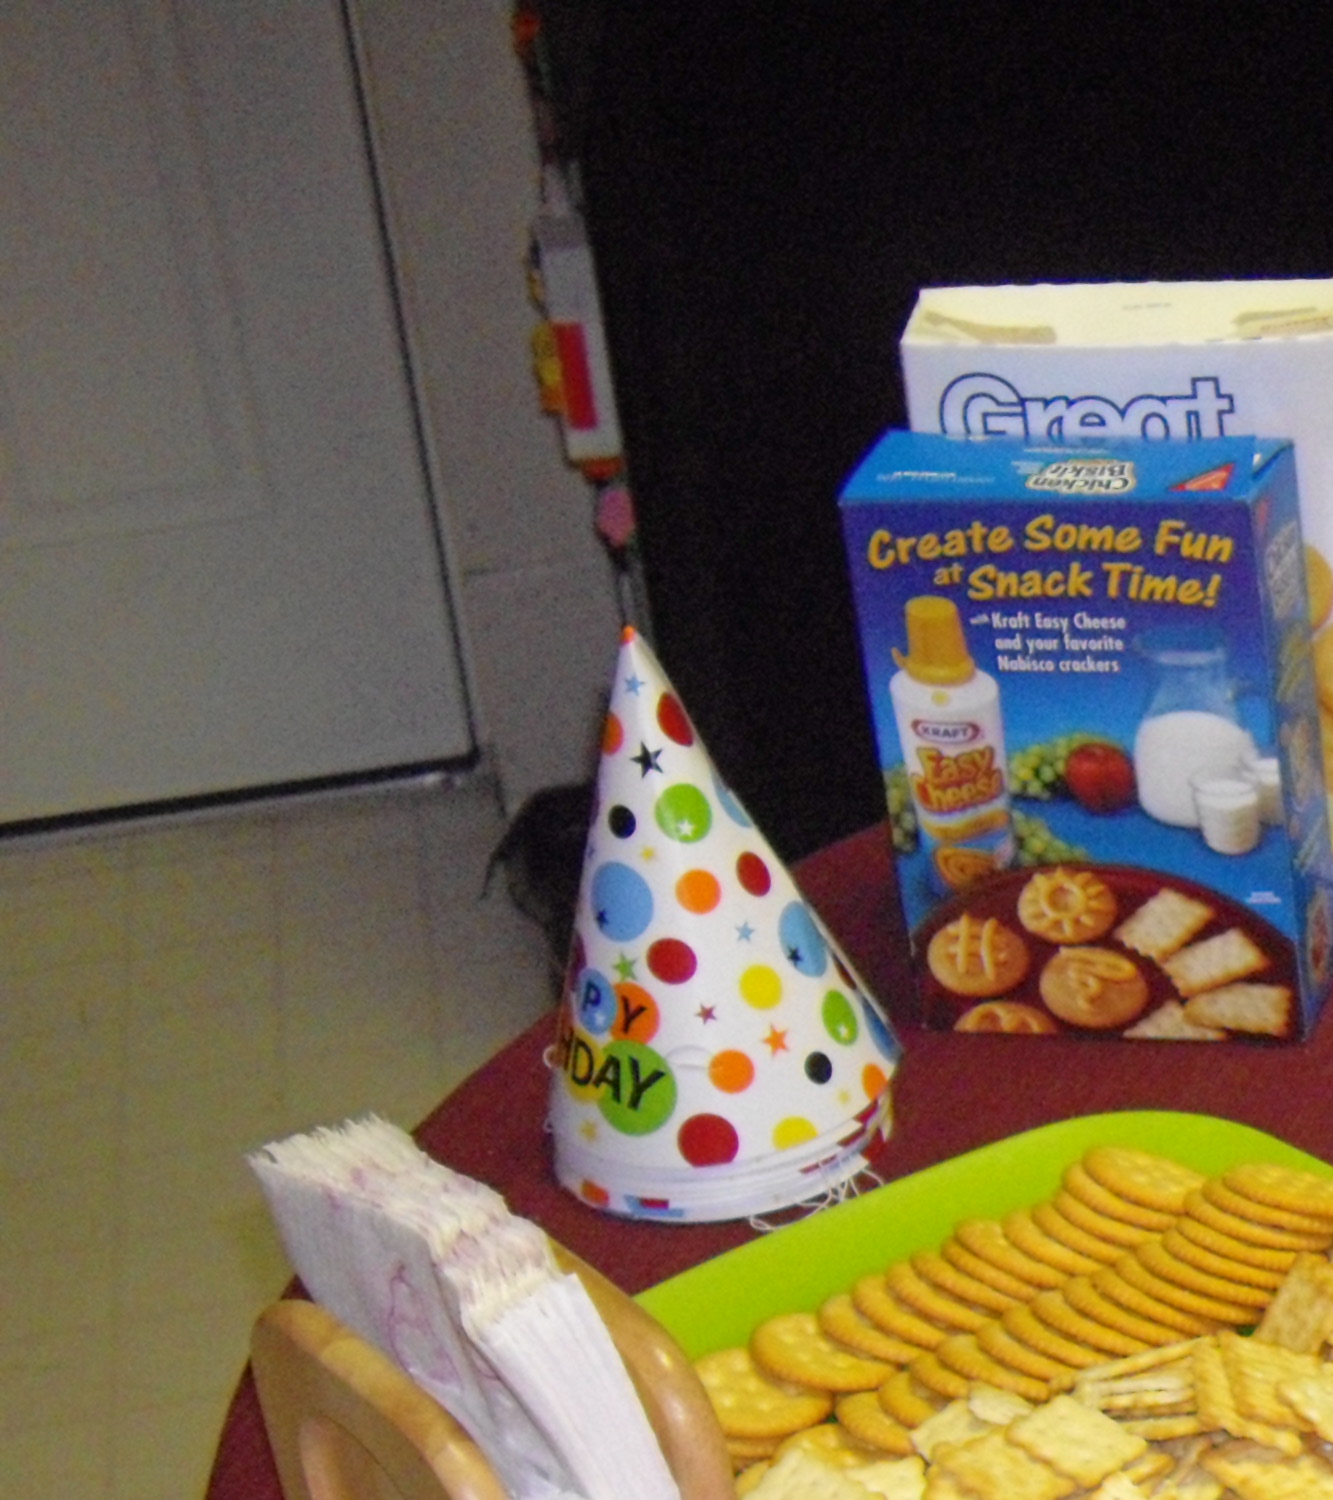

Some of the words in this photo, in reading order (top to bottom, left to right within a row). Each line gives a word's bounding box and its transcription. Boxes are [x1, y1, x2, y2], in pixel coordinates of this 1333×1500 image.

[939, 371, 1236, 438] Great
[867, 521, 1014, 569] Create
[1023, 515, 1144, 552] Some
[1153, 519, 1234, 563] Fun
[933, 563, 964, 586] at
[967, 562, 1095, 601] Snack
[1101, 562, 1224, 608] Time!
[991, 611, 1031, 629] Kraft
[1034, 612, 1069, 633] Easy
[1073, 612, 1127, 629] Cheese
[995, 632, 1022, 650] and
[1026, 637, 1059, 654] your
[1063, 633, 1125, 651] favorite
[997, 655, 1055, 672] Nabisco
[1059, 655, 1120, 673] crackers
[921, 725, 969, 738] KRAFT
[916, 745, 995, 782] Easy
[910, 768, 1003, 813] Cheese
